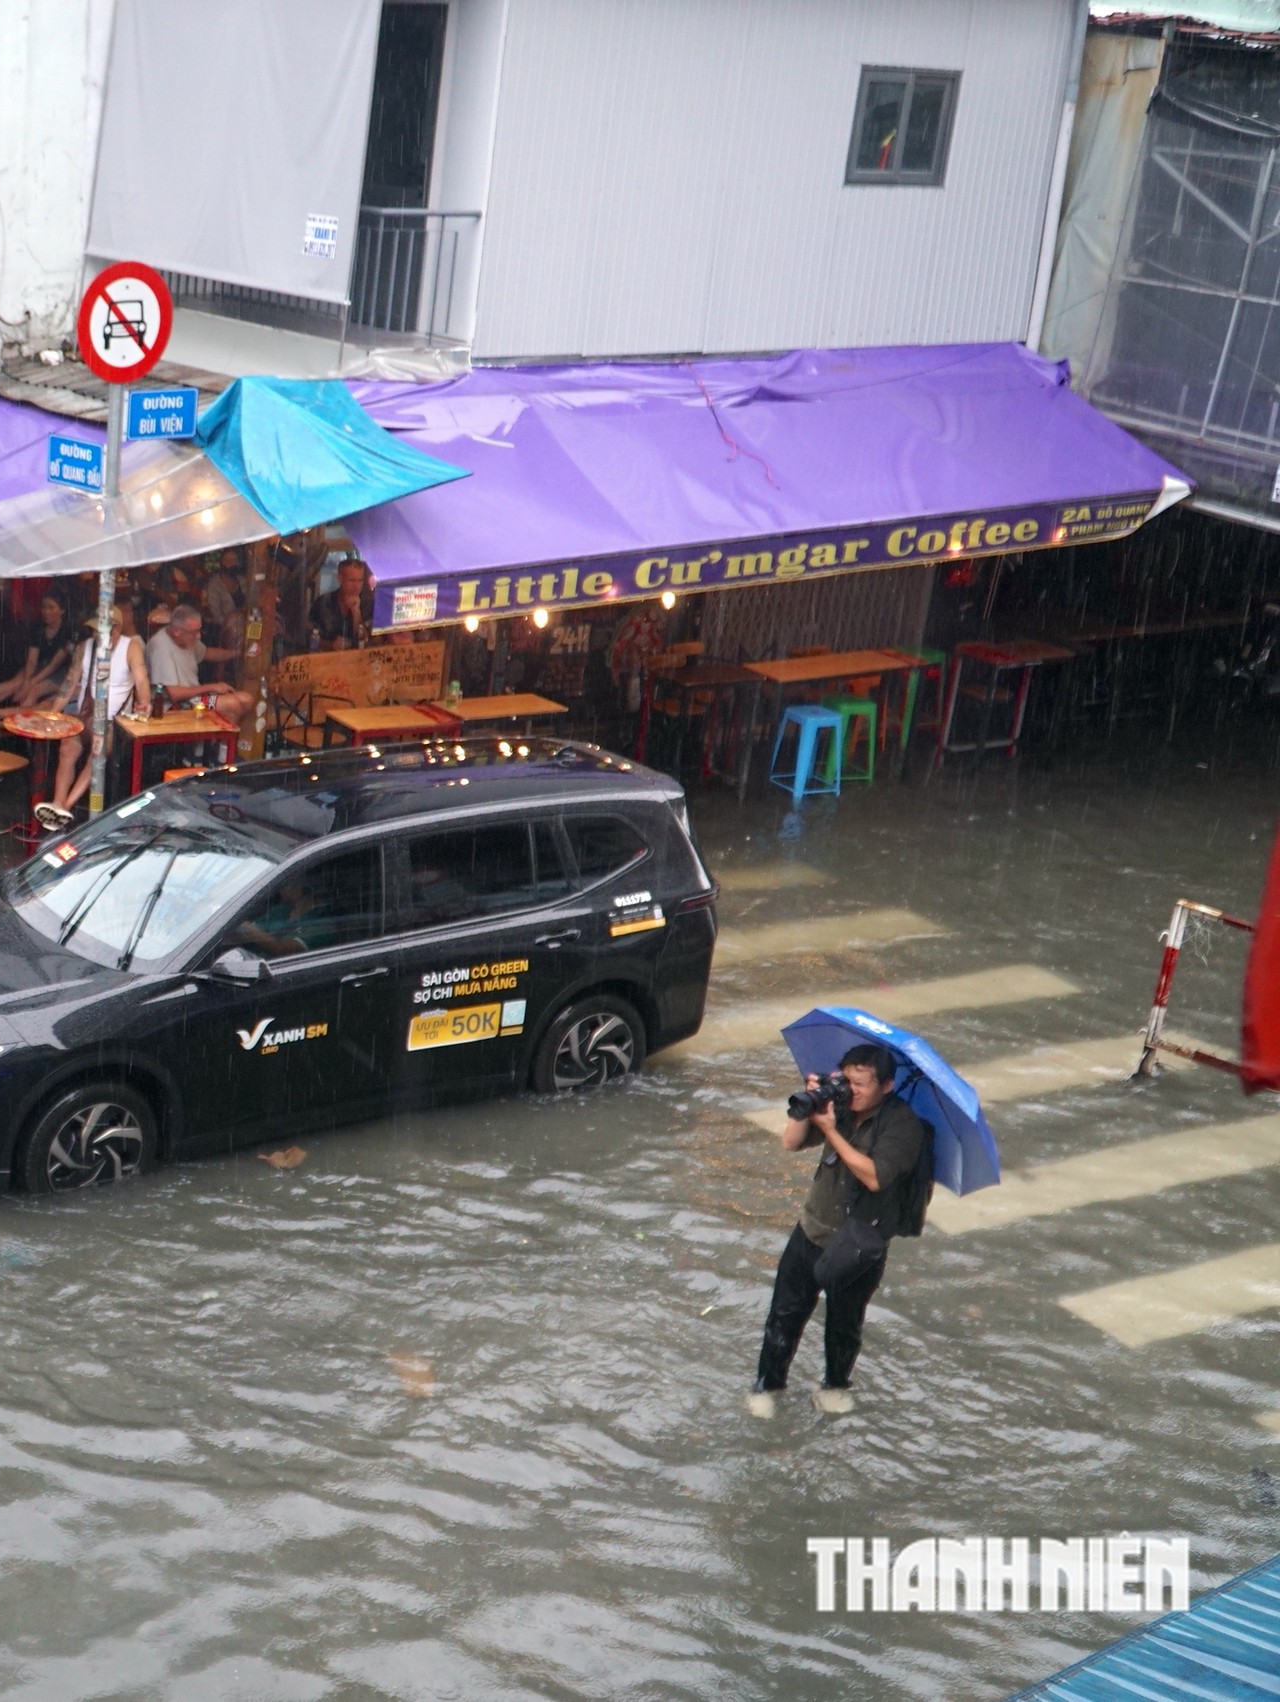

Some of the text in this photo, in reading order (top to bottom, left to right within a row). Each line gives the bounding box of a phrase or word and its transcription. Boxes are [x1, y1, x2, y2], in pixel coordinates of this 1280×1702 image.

[143, 394, 183, 410] ĐƯỜNG
[139, 412, 183, 435] BÙI VIỆN
[59, 443, 92, 462] ĐƯỜNG
[62, 463, 85, 483] QUANG
[1062, 505, 1091, 523] 2A
[457, 567, 614, 613] Little
[887, 518, 1039, 558] Coffee
[550, 624, 591, 655] 24H
[422, 959, 529, 988] SÀI GÒN CÓ GREEN
[413, 989, 431, 1005] SỢ
[432, 986, 453, 1001] CHI
[454, 981, 481, 997] MƯA
[262, 1022, 329, 1048] XANH SM
[451, 1011, 497, 1037] 50K
